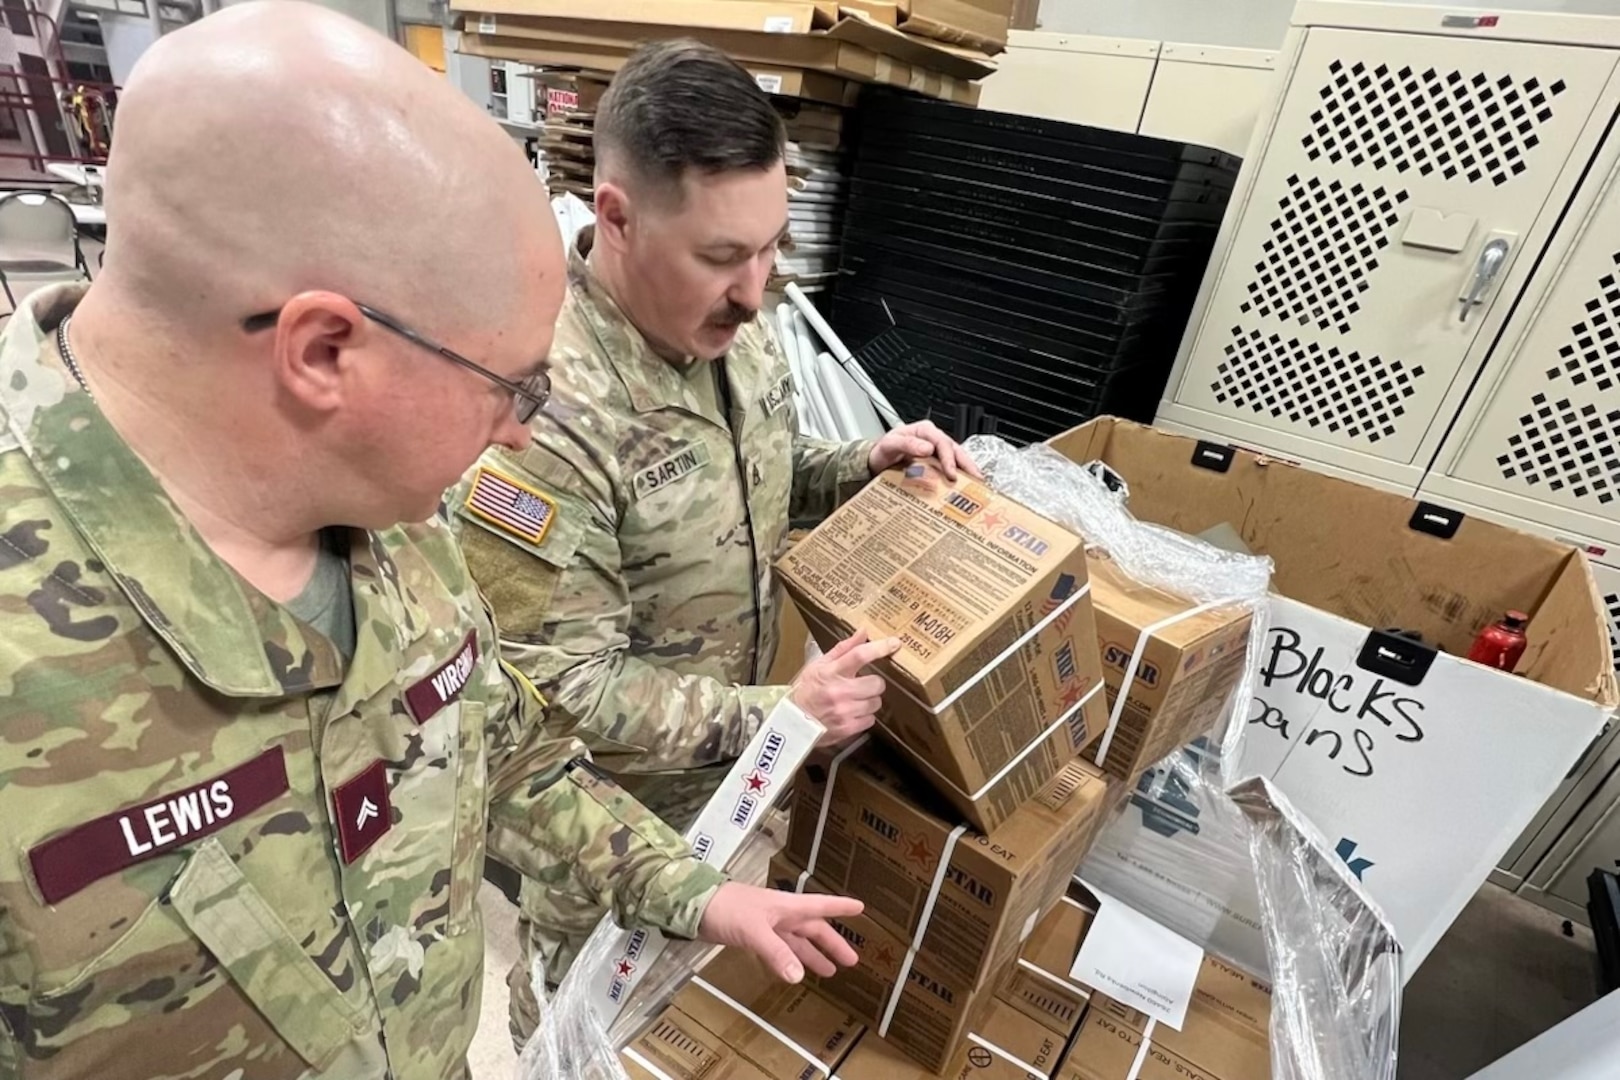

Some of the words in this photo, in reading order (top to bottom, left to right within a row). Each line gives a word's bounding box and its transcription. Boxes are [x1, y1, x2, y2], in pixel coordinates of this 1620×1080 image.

[646, 450, 697, 487] SARTIN
[945, 491, 980, 515] MRE
[1003, 525, 1048, 556] STAR
[985, 540, 1038, 574] INFORMATION
[914, 611, 956, 645] M-018H
[1055, 640, 1076, 683] MRE
[734, 796, 754, 826] MRE
[759, 733, 782, 771] STAR
[119, 780, 234, 856] LEWIS
[861, 807, 900, 844] MRE
[990, 844, 1016, 862] EAT
[627, 929, 646, 959] STAR
[1096, 1016, 1117, 1034] EAT
[1042, 1036, 1055, 1057] EAT
